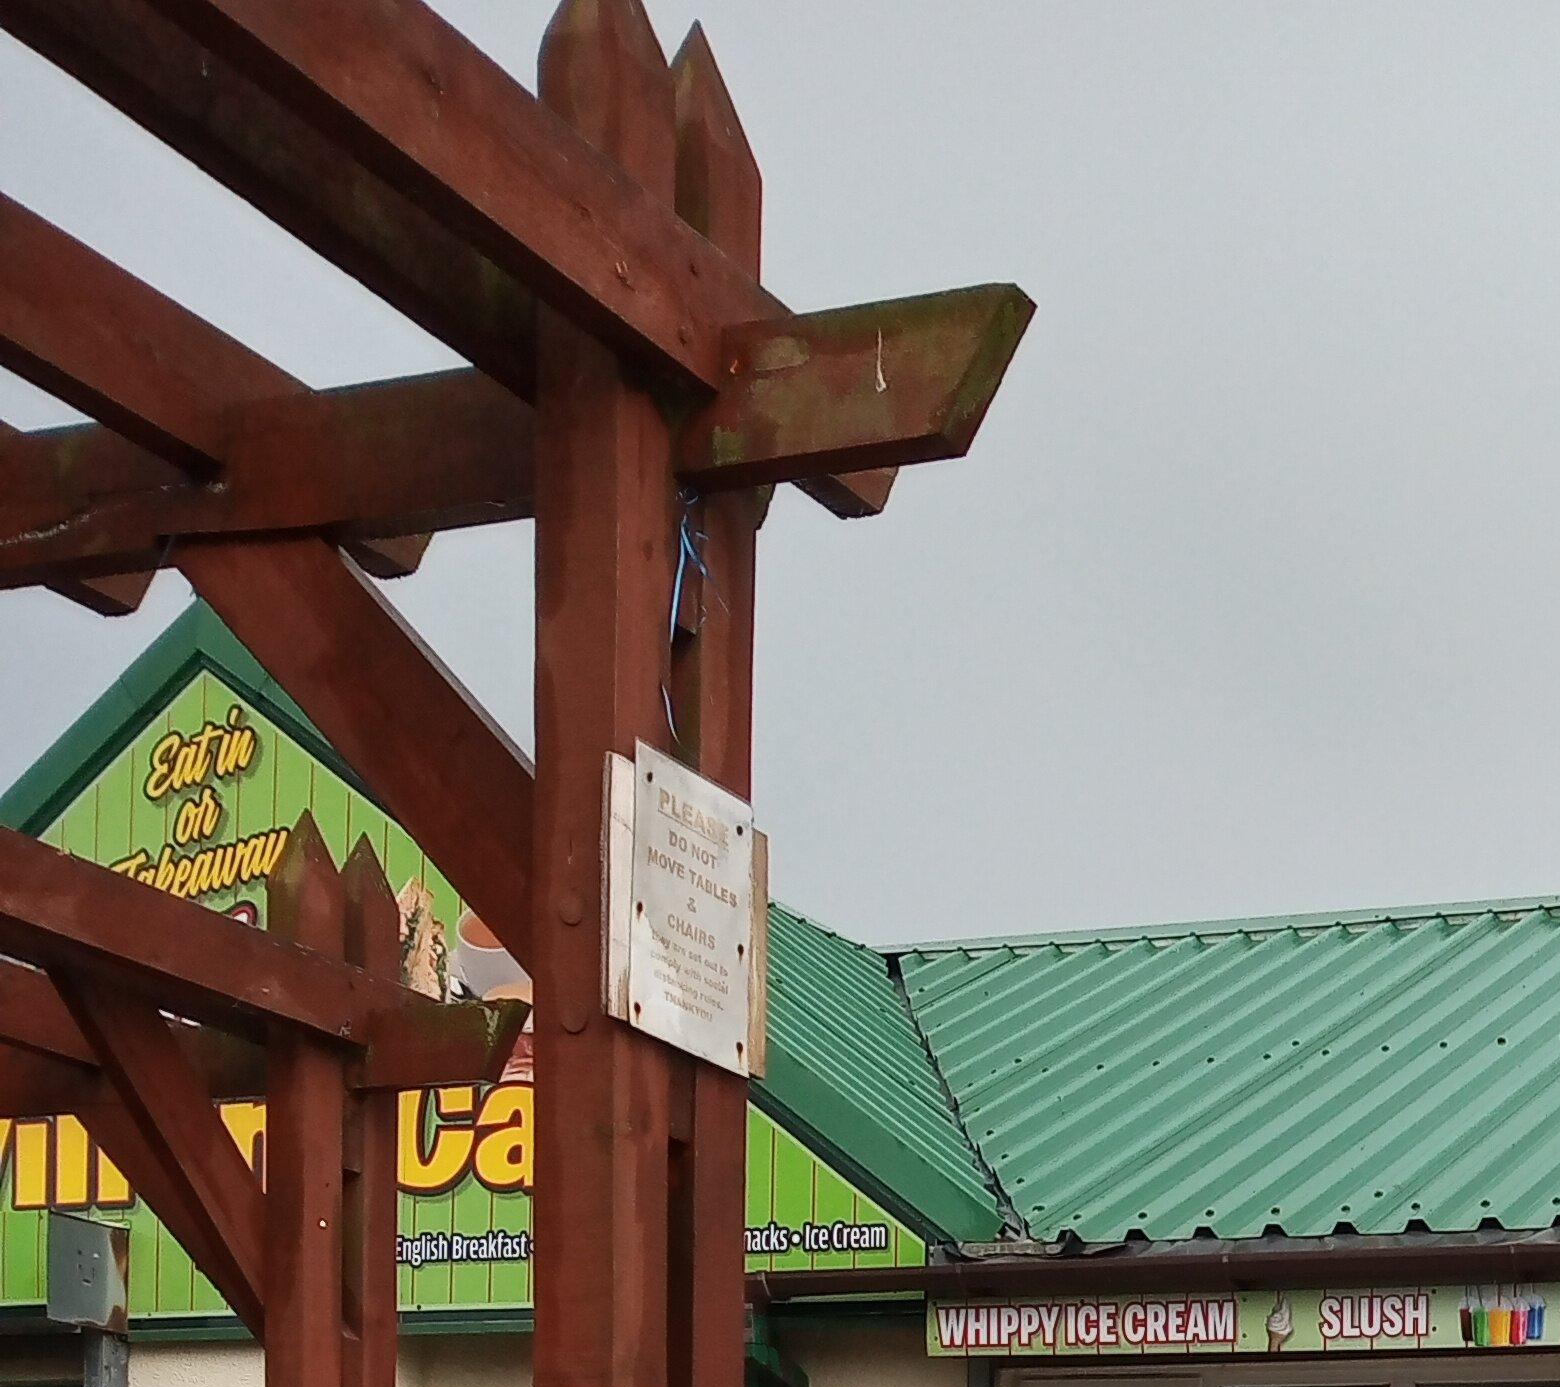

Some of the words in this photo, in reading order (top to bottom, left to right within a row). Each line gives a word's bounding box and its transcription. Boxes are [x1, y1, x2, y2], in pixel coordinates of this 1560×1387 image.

[146, 725, 212, 797] Eat
[215, 708, 256, 776] in
[175, 788, 221, 844] or
[659, 788, 730, 847] PLEASE
[669, 830, 688, 851] DO
[692, 843, 718, 869] NOT
[647, 846, 685, 879] MOVE
[689, 868, 738, 908] TABLES
[687, 897, 697, 913] &
[667, 914, 716, 950] CHAIRS
[396, 1235, 448, 1265] English
[452, 1232, 527, 1259] Breakfast
[804, 1225, 829, 1249] Ice
[832, 1223, 886, 1249] Cream
[937, 1306, 1061, 1347] WHIPPY
[1065, 1304, 1118, 1345] ICE
[1123, 1300, 1236, 1344] CREAM
[1319, 1294, 1428, 1338] SLUSH
